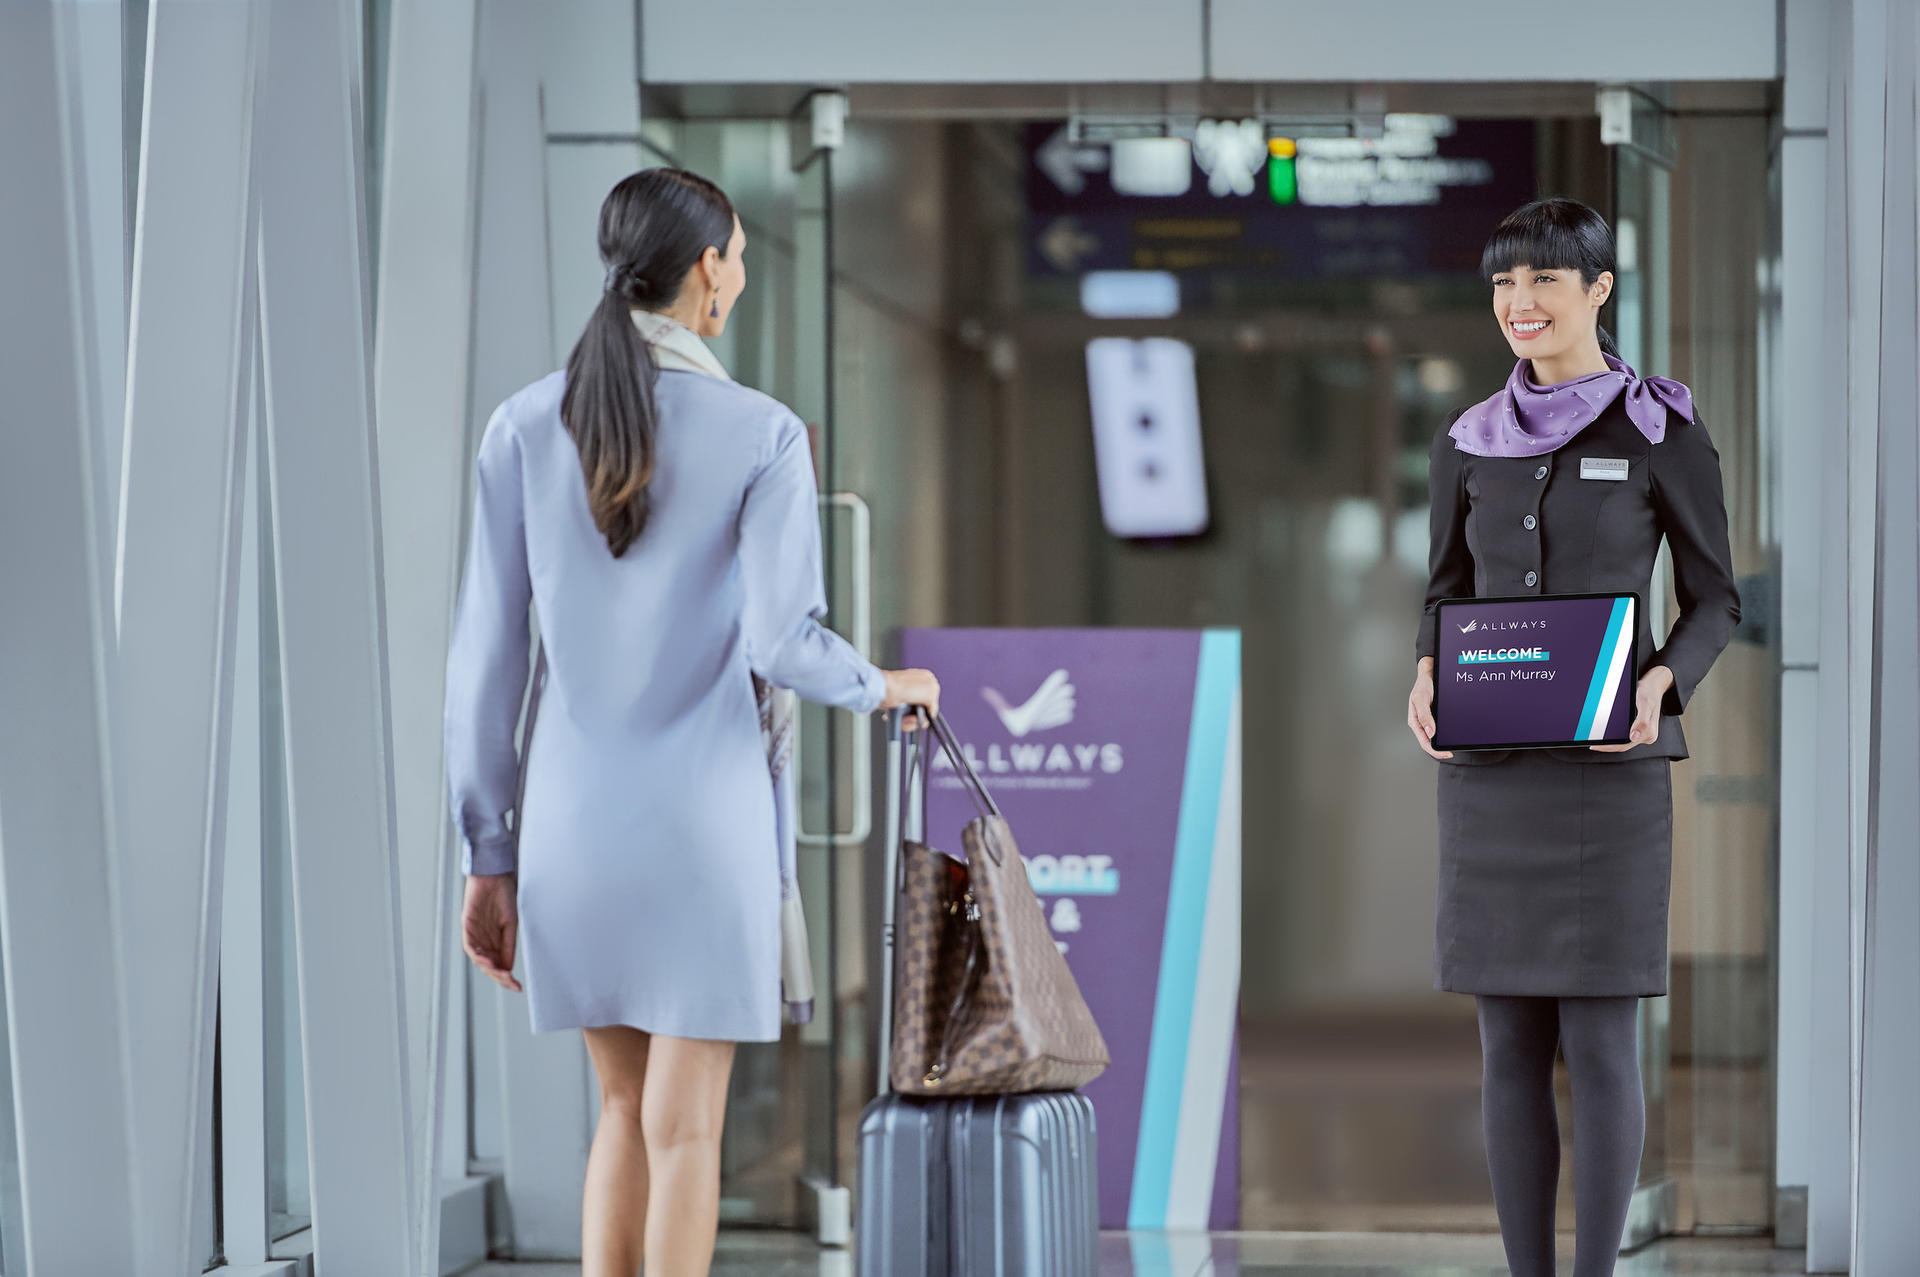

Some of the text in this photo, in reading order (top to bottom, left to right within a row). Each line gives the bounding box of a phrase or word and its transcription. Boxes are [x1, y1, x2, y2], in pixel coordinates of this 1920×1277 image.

[1480, 620, 1547, 631] ALLWAYS
[1461, 647, 1542, 662] WELCOME
[1456, 669, 1556, 682] Ms Ann Murray
[931, 742, 1124, 774] ALLWAYS
